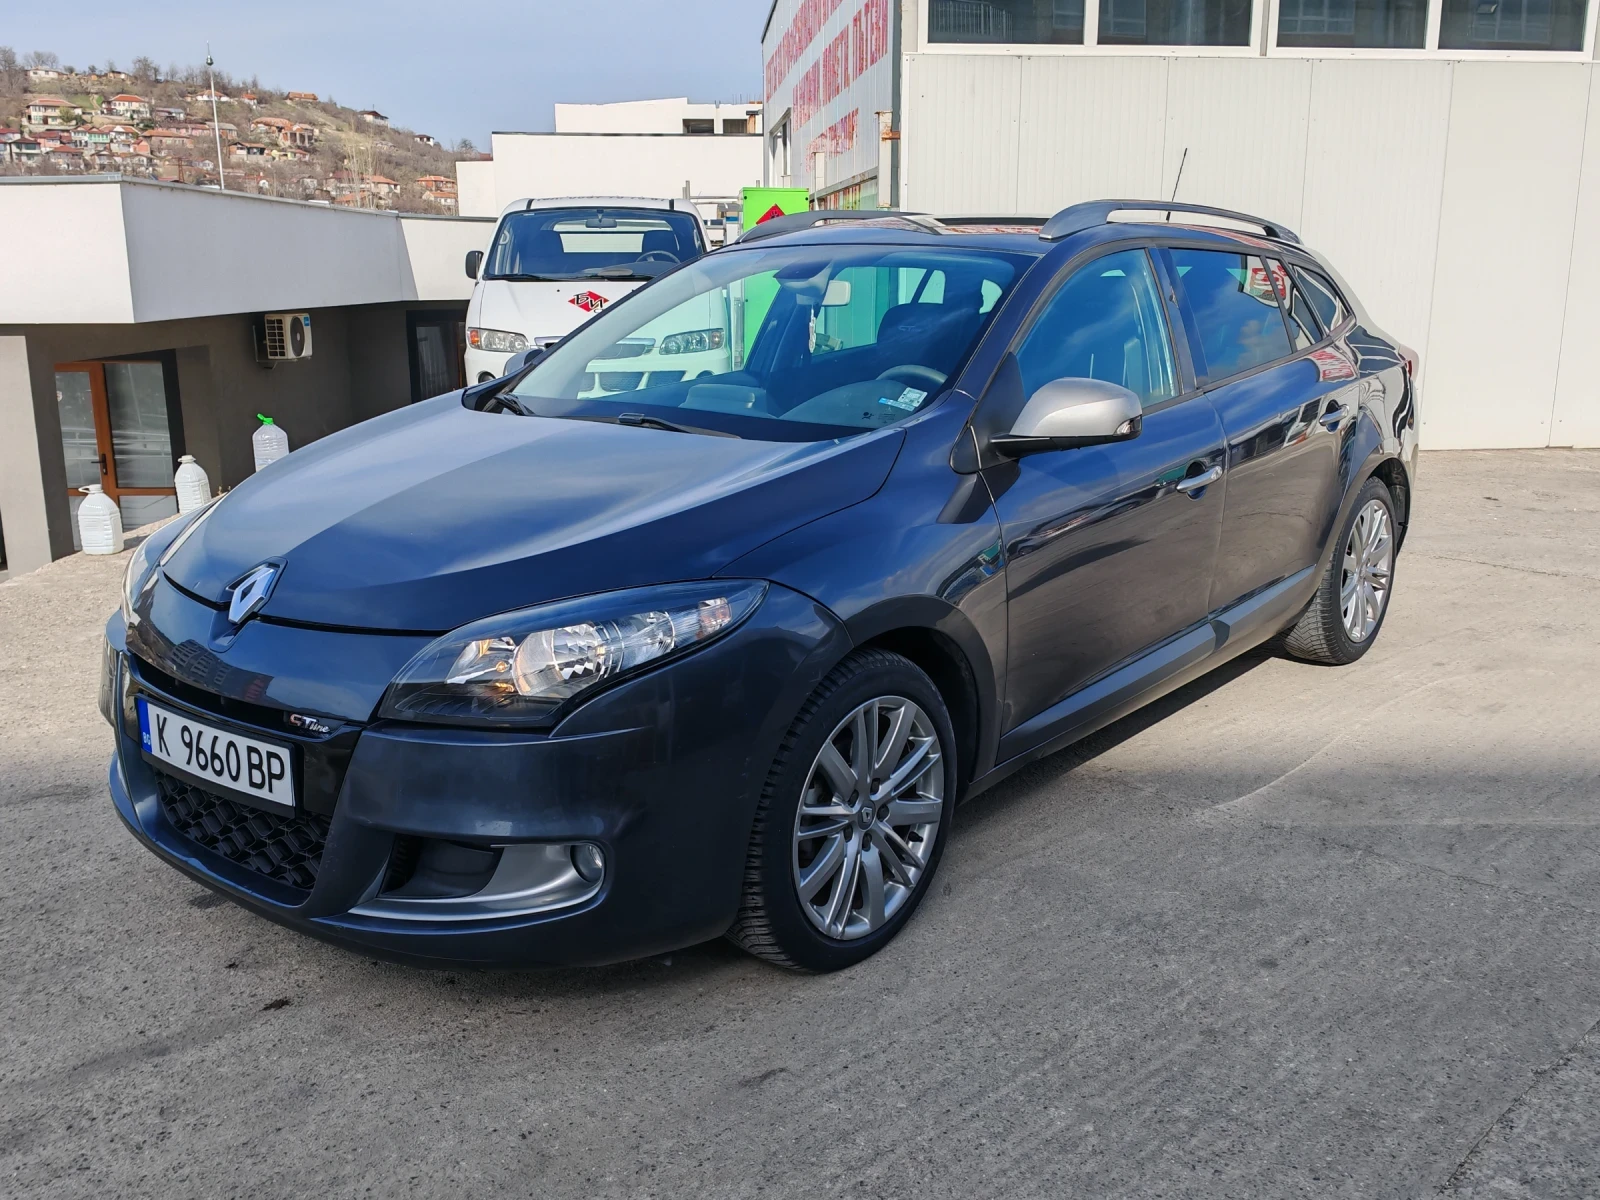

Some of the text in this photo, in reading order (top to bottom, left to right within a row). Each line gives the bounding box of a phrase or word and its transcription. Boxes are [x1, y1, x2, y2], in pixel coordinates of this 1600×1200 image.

[156, 713, 285, 793] K 9660 BP
